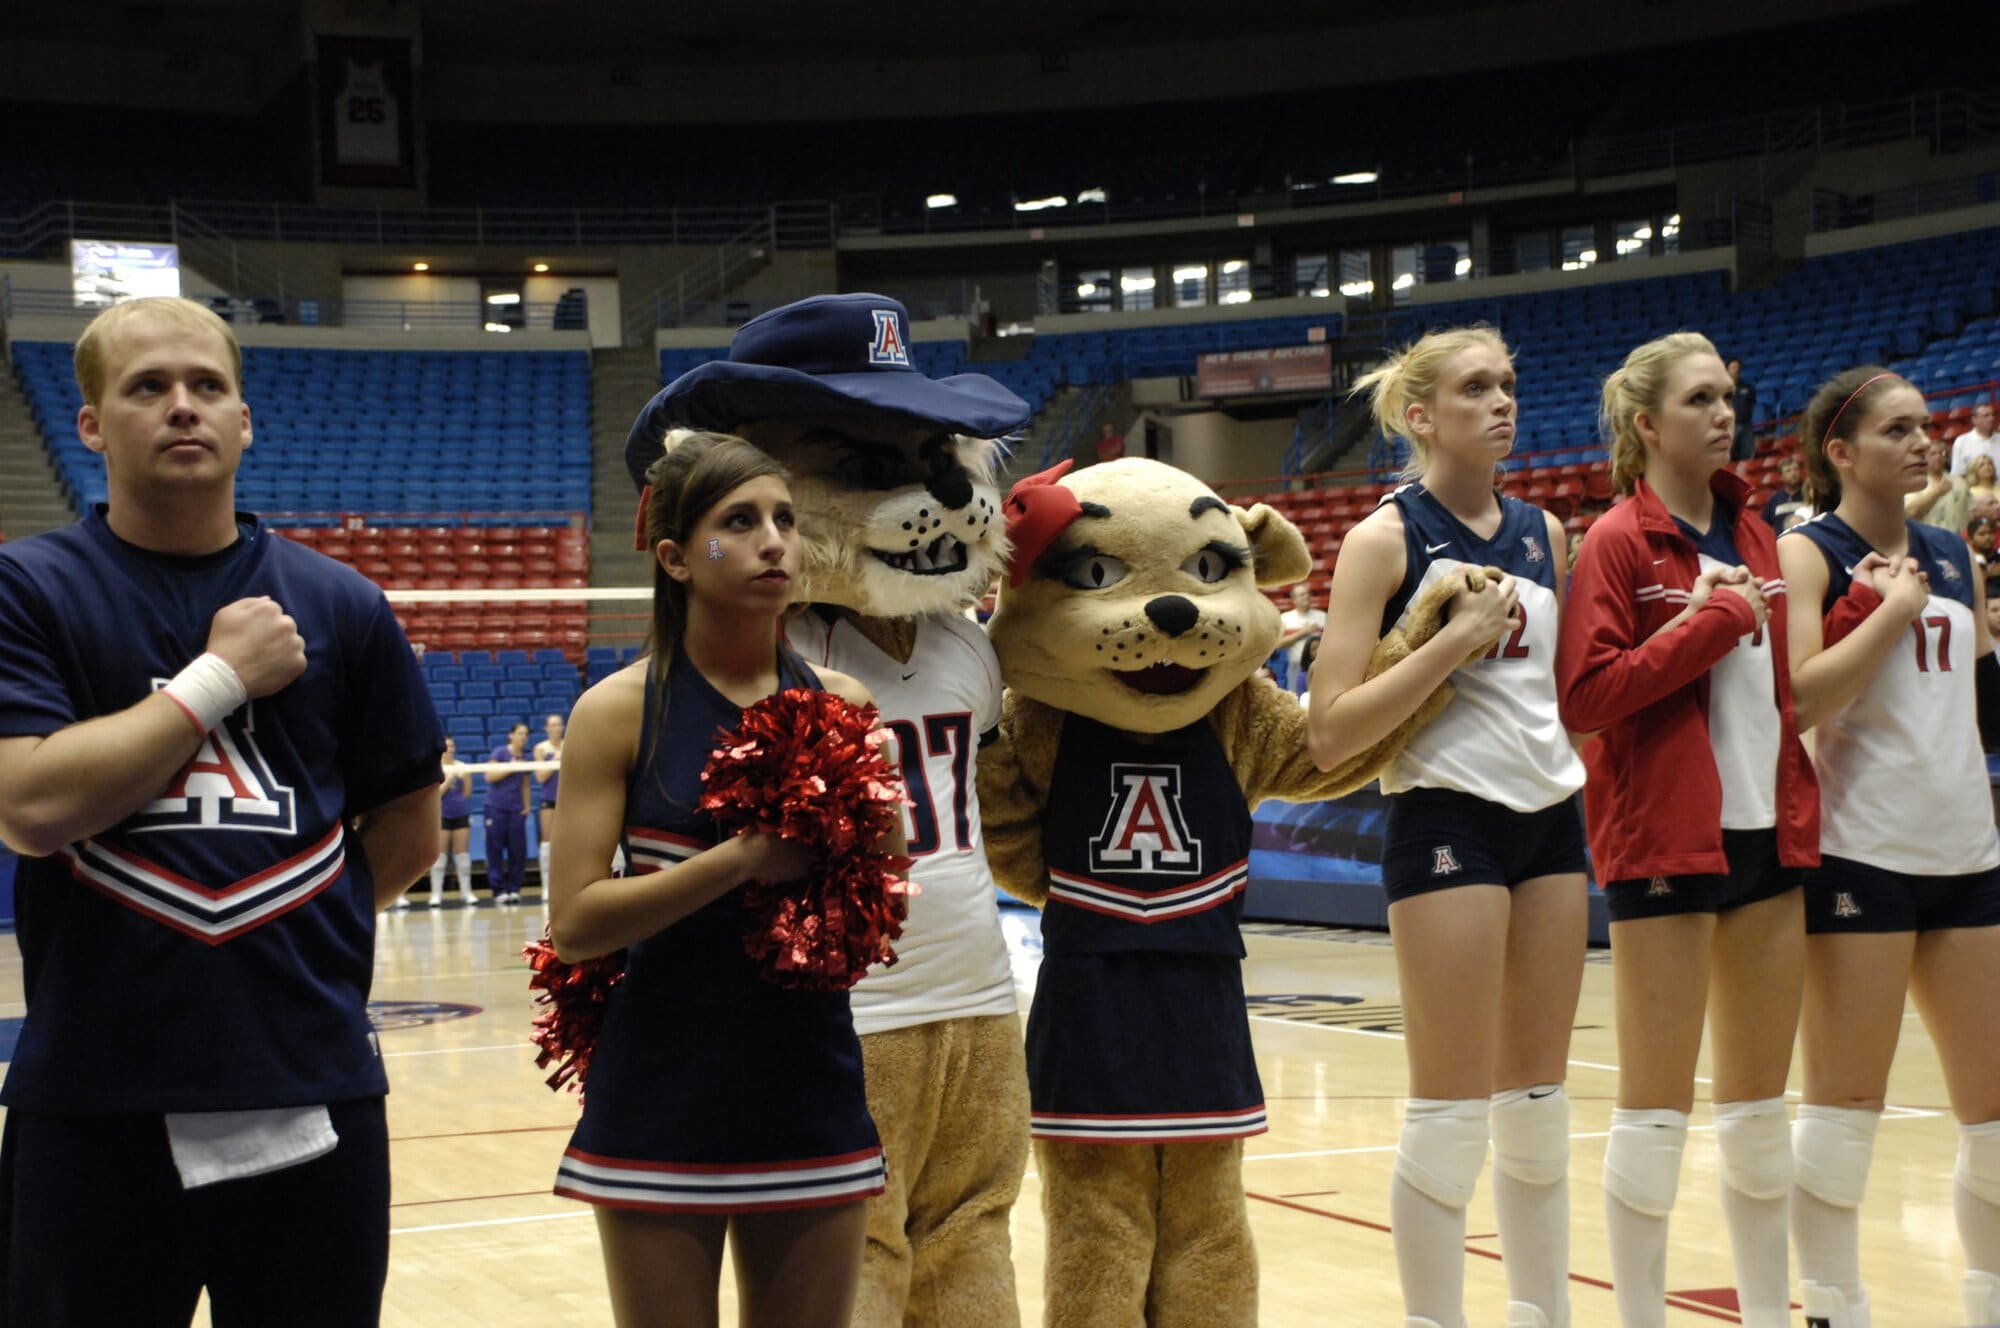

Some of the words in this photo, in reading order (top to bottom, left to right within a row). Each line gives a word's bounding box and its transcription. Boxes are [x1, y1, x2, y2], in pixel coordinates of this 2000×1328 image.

[869, 310, 909, 366] A
[707, 538, 727, 560] A
[1485, 601, 1530, 659] 2
[1911, 616, 1952, 672] 17
[128, 678, 297, 835] A
[1089, 763, 1202, 875] A
[1432, 845, 1462, 877] A
[1833, 891, 1862, 918] A
